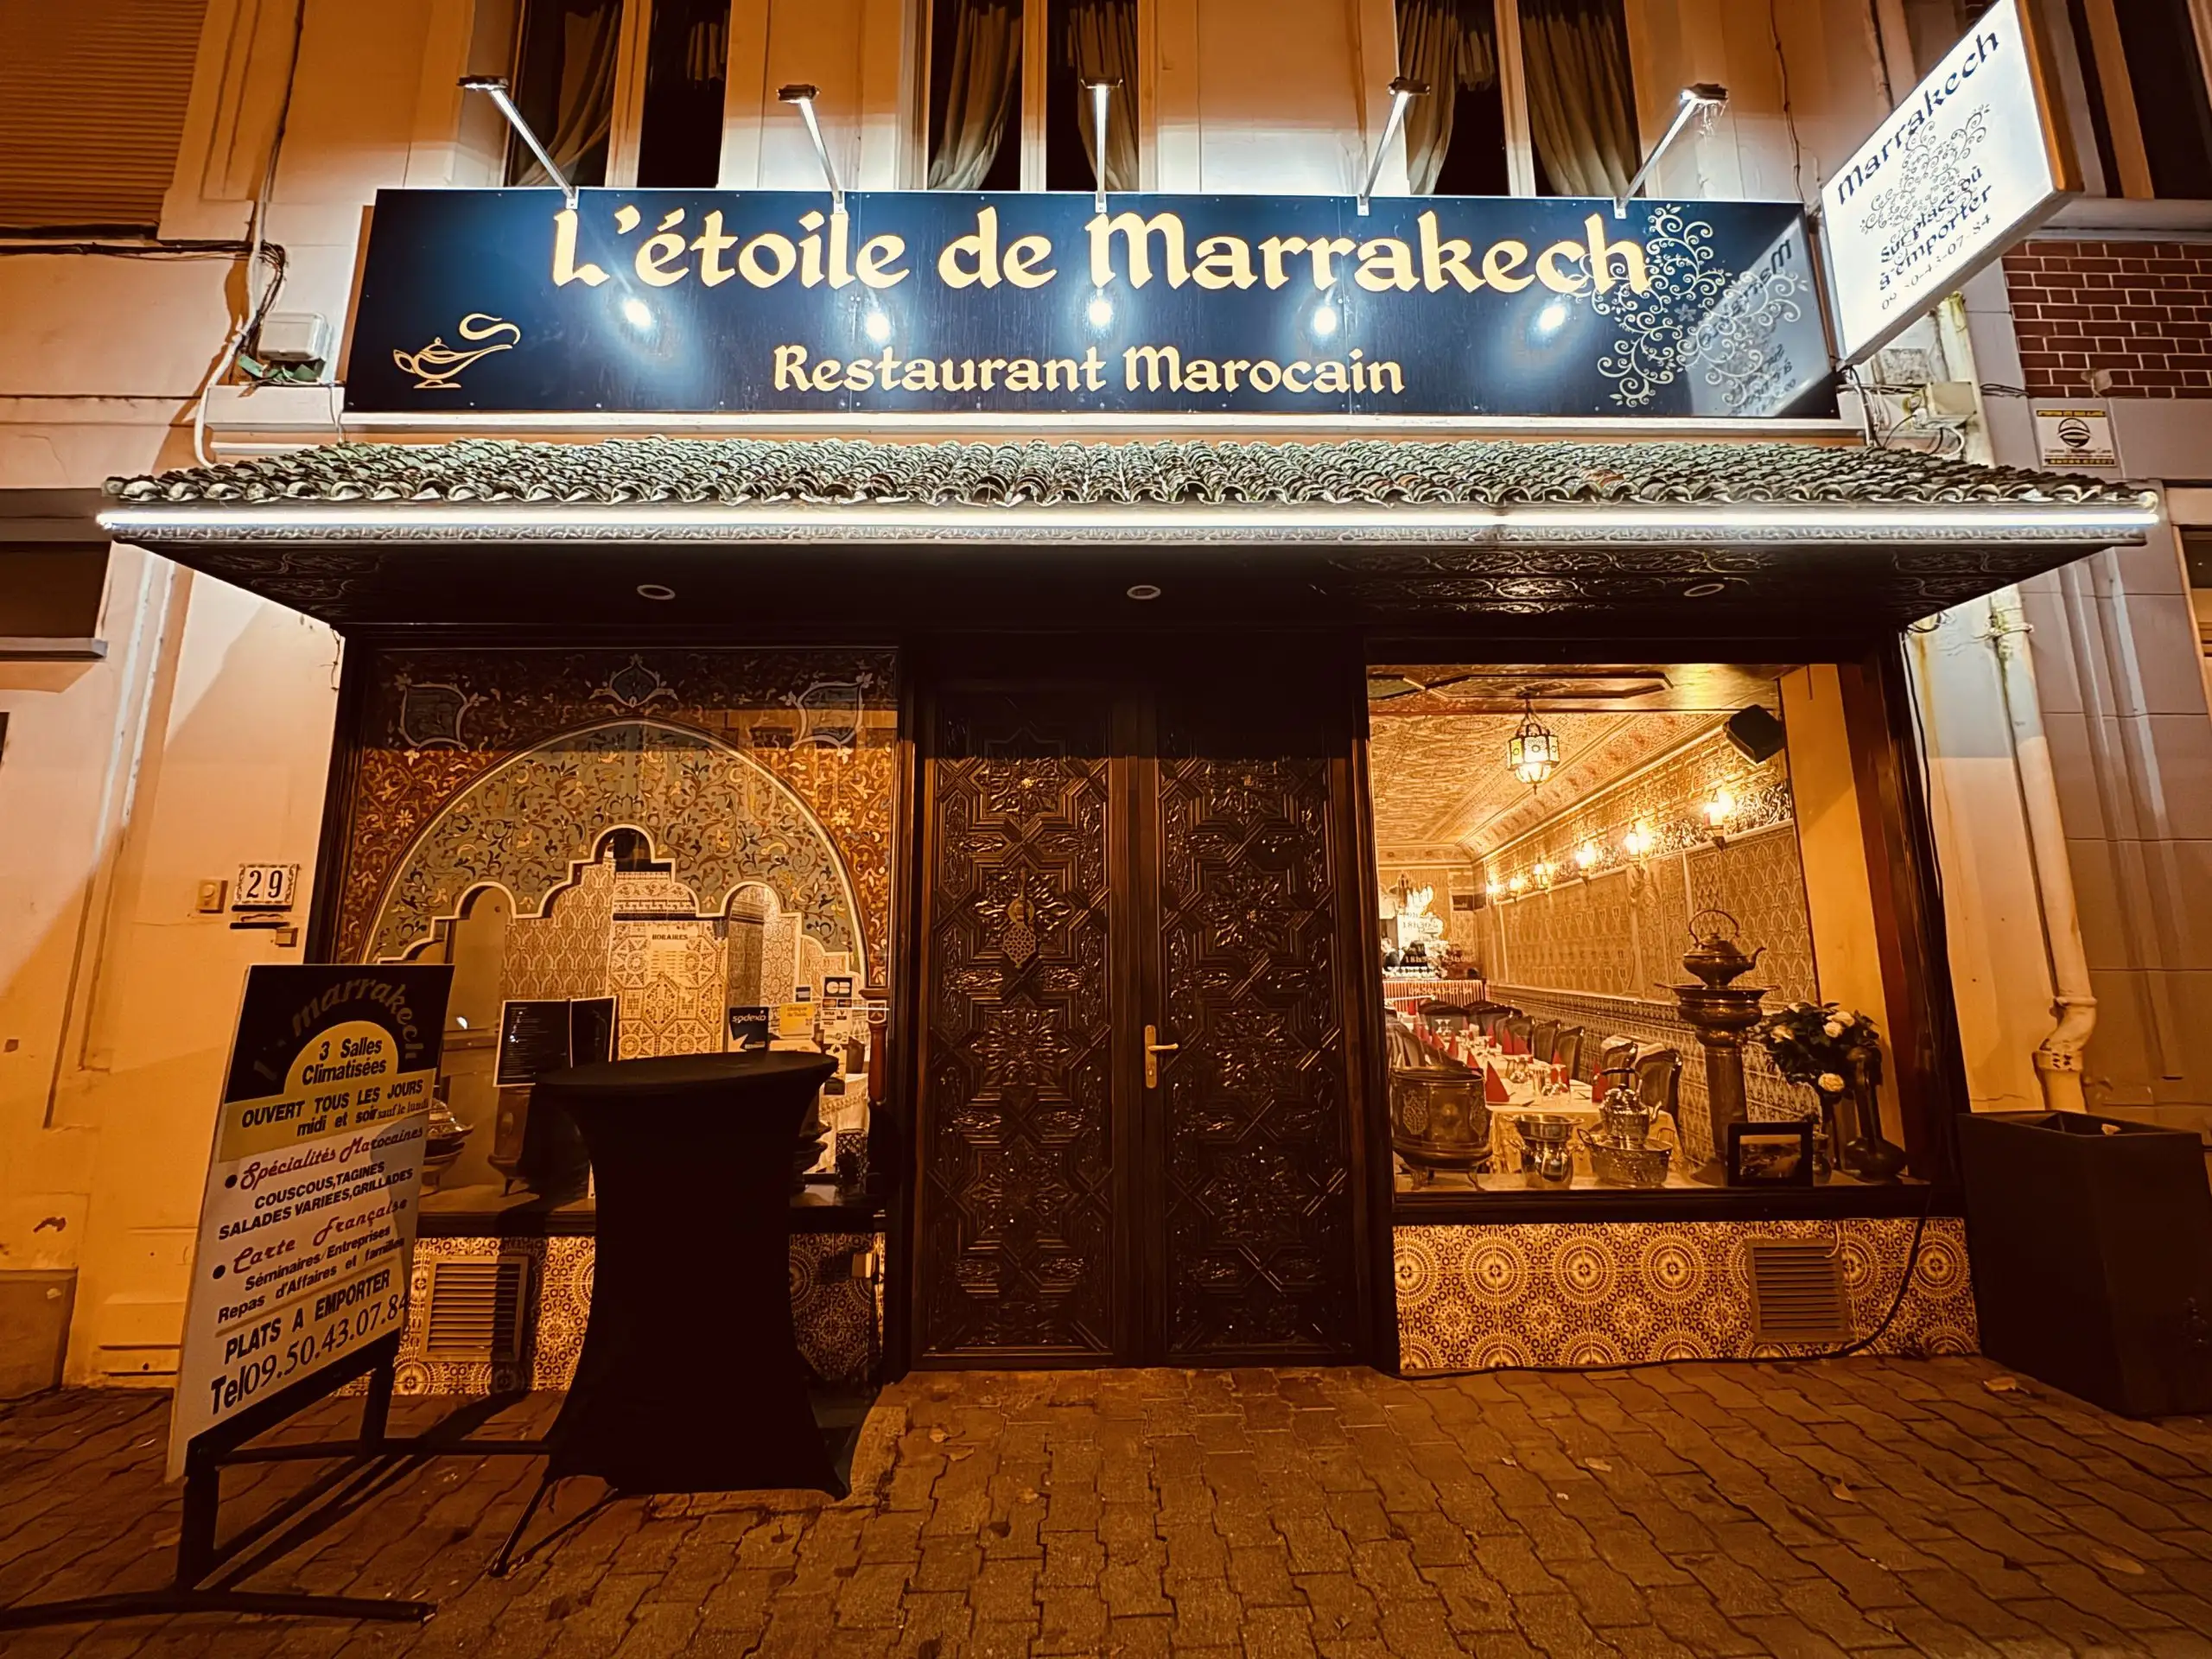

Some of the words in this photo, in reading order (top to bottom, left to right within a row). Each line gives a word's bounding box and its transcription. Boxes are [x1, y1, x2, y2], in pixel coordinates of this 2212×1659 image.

[1837, 29, 1999, 206] Marrakech
[552, 204, 910, 289] L'étoile
[938, 206, 1058, 289] de
[1084, 210, 1652, 294] Marrakech
[1896, 185, 1993, 276] emporter
[773, 344, 1108, 392] Restaurant
[1122, 345, 1406, 394] Marocain
[246, 869, 283, 899] 29
[302, 1057, 387, 1085] Climatisées
[320, 1040, 330, 1061] 3
[340, 1036, 383, 1058] Salles
[241, 1100, 305, 1128] OUVERT
[315, 1092, 350, 1114] TOUS
[357, 1086, 381, 1105] LES
[387, 1078, 423, 1100] JOURS
[296, 1116, 327, 1137] midi
[335, 1111, 347, 1128] et
[240, 1147, 336, 1191] Spécialités
[339, 1126, 423, 1164] Marocaines
[218, 1205, 292, 1241] SALADES
[232, 1238, 296, 1274] Carte
[312, 1198, 408, 1247] Française
[217, 1295, 266, 1325] Repas
[275, 1264, 338, 1300] d'Affaires
[345, 1255, 357, 1270] et
[224, 1317, 282, 1365] PLATS
[291, 1307, 304, 1333] A
[315, 1268, 391, 1322] EMPORTER
